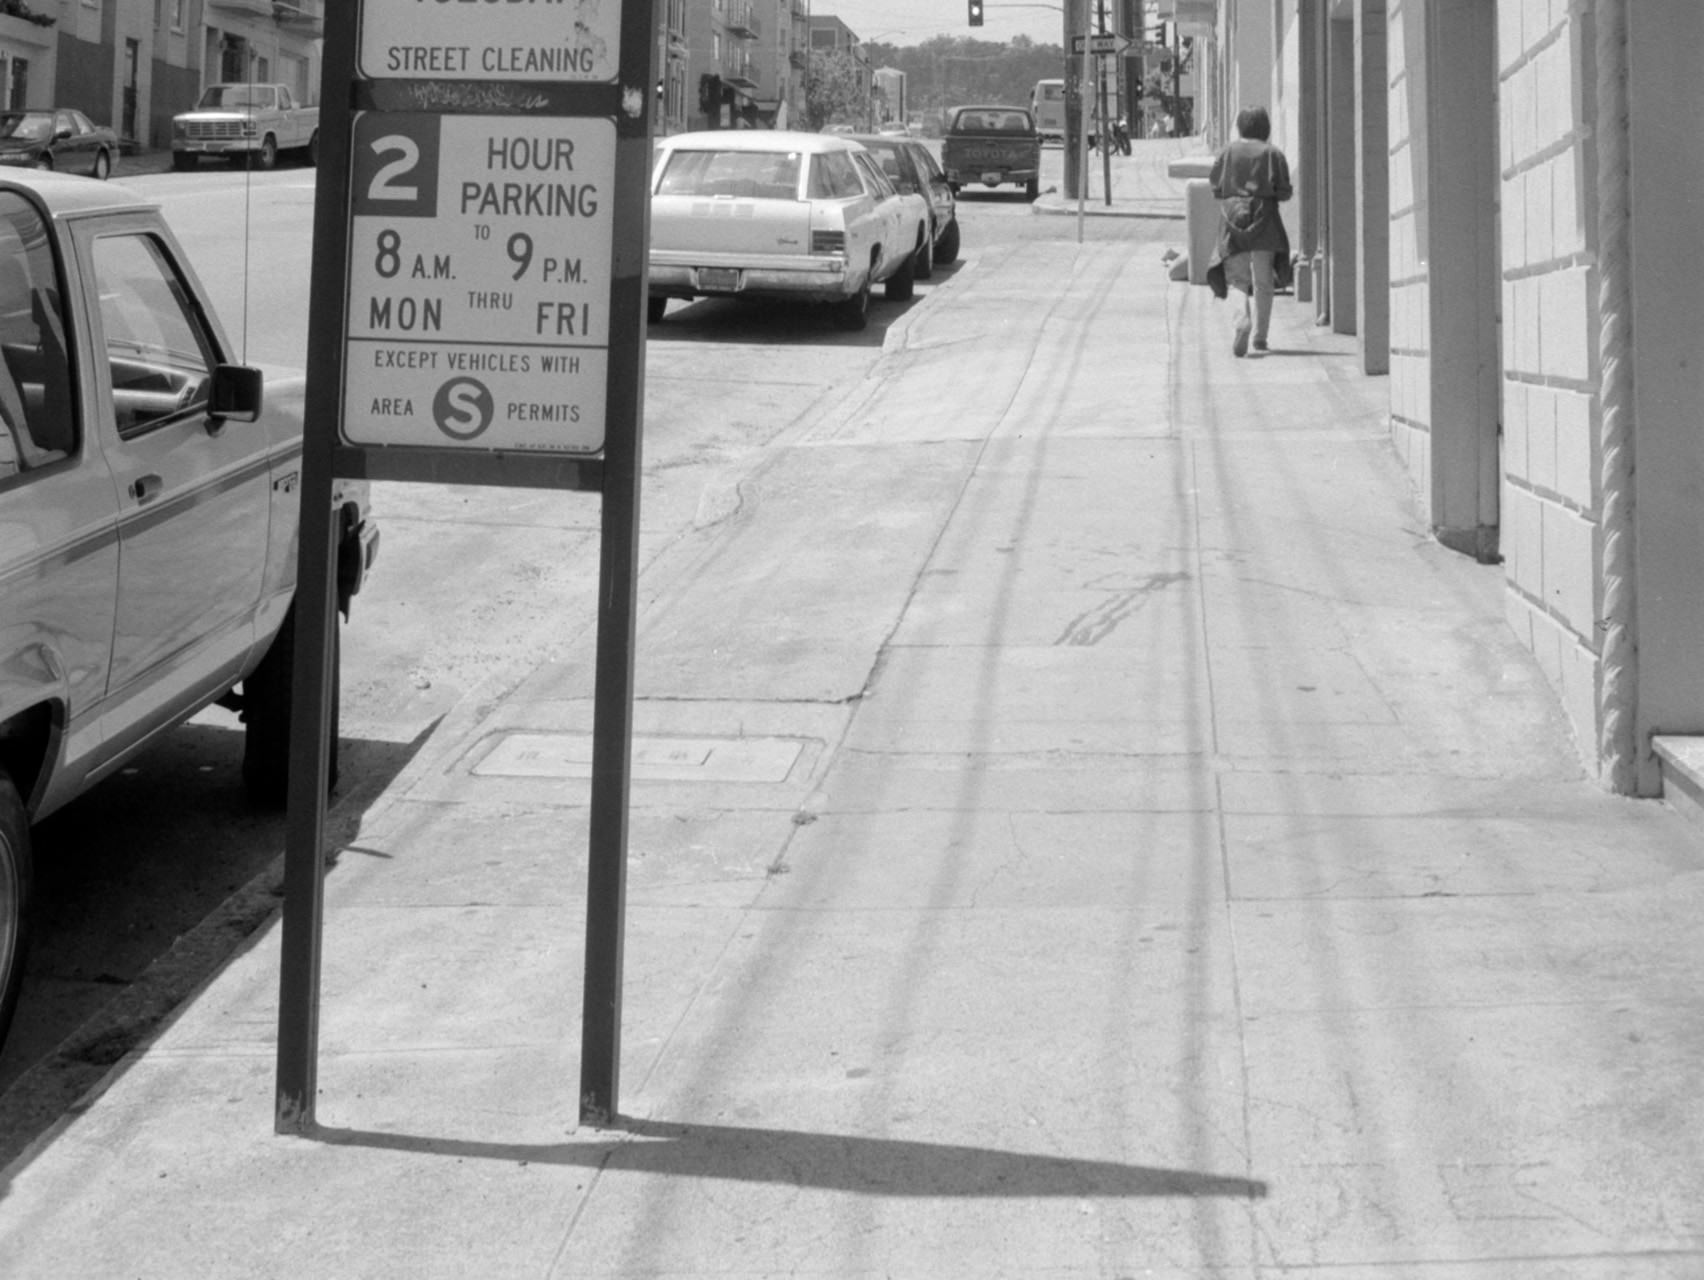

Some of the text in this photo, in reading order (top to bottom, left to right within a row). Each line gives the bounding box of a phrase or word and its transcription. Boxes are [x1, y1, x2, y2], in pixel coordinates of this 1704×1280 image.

[387, 46, 593, 72] STREET CLEANING
[368, 135, 419, 200] 2
[488, 137, 574, 171] HOUR
[964, 148, 1018, 160] TOYOTA
[461, 182, 597, 218] PARKING
[474, 224, 490, 240] TO
[370, 291, 588, 336] MON THRU FRI
[375, 350, 579, 373] EXCEPT VEHICLES WITH
[371, 382, 580, 434] AREA S PERMITS
